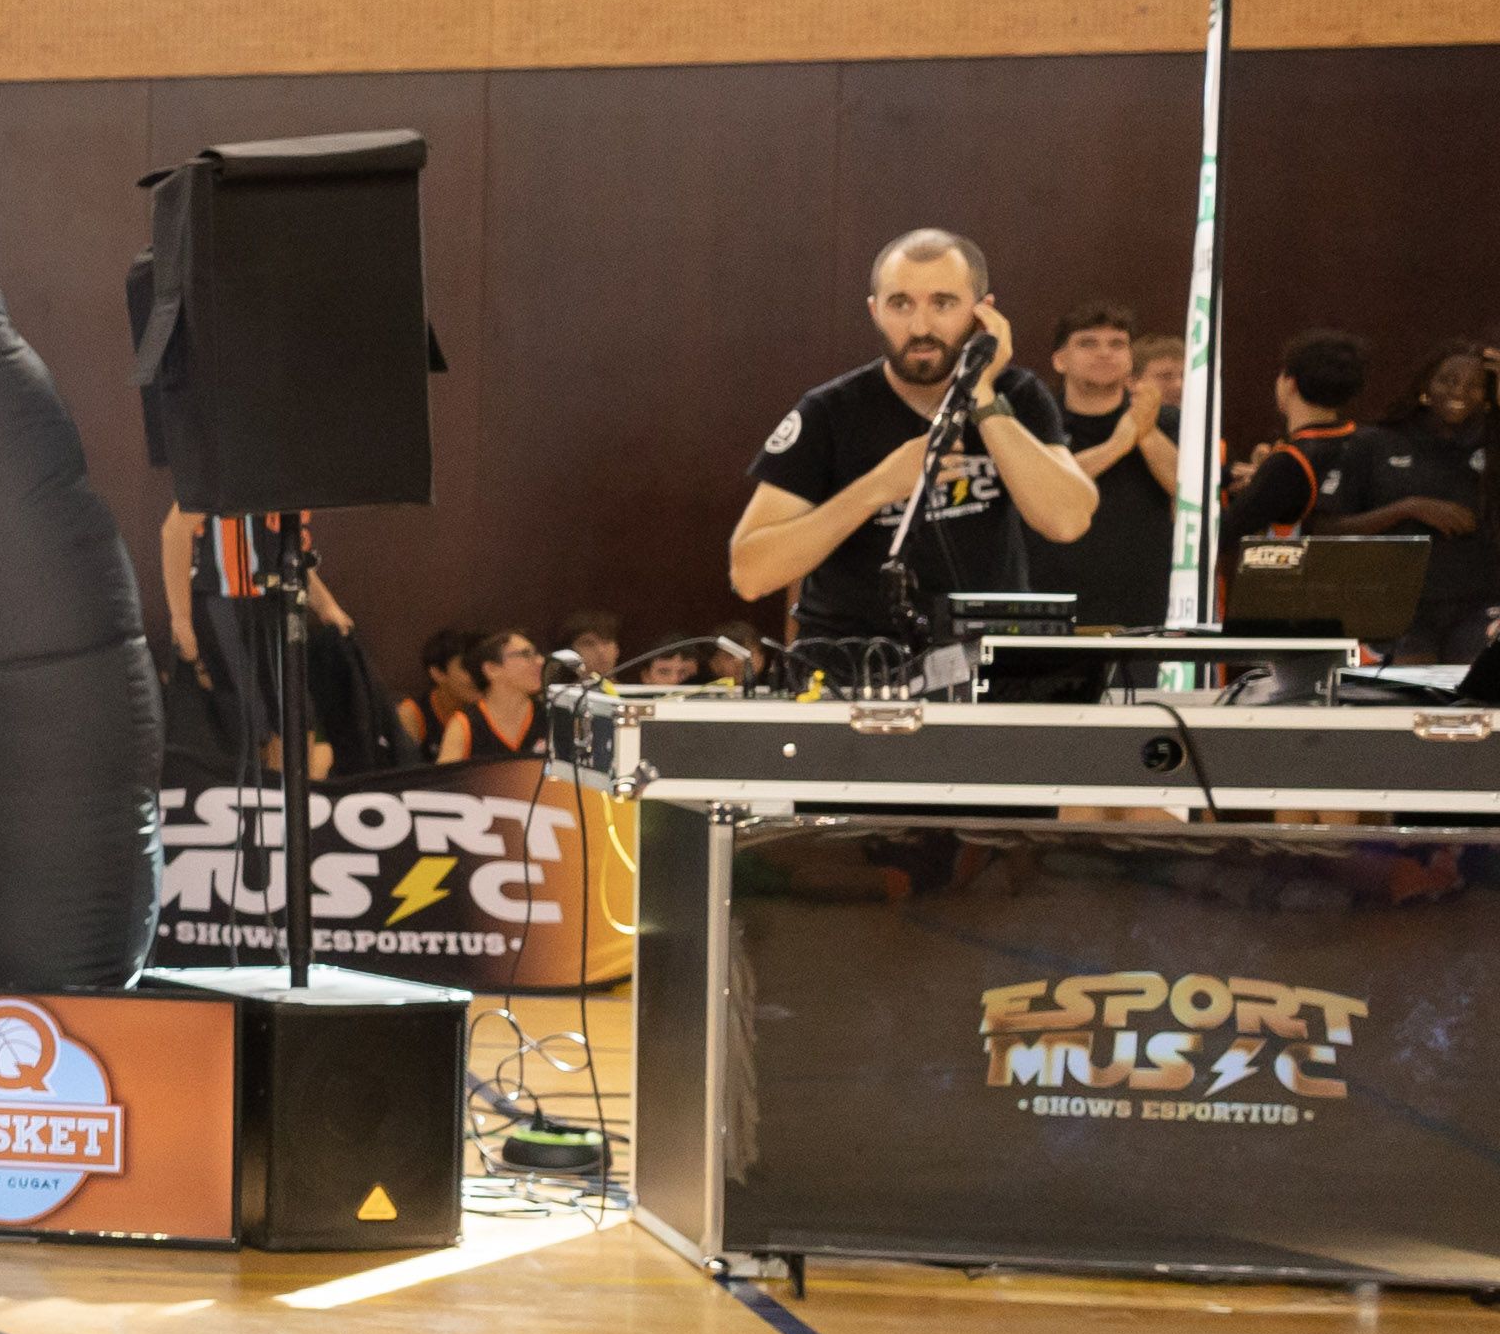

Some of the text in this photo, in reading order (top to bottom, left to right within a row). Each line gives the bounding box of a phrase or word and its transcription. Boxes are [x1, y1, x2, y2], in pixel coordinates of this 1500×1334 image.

[311, 927, 507, 957] ESPORTIUS
[979, 971, 1369, 1046] ESPORT
[1032, 1095, 1298, 1125] SHOWS ESPORTIUS
[7, 1176, 61, 1191] CUGAT
